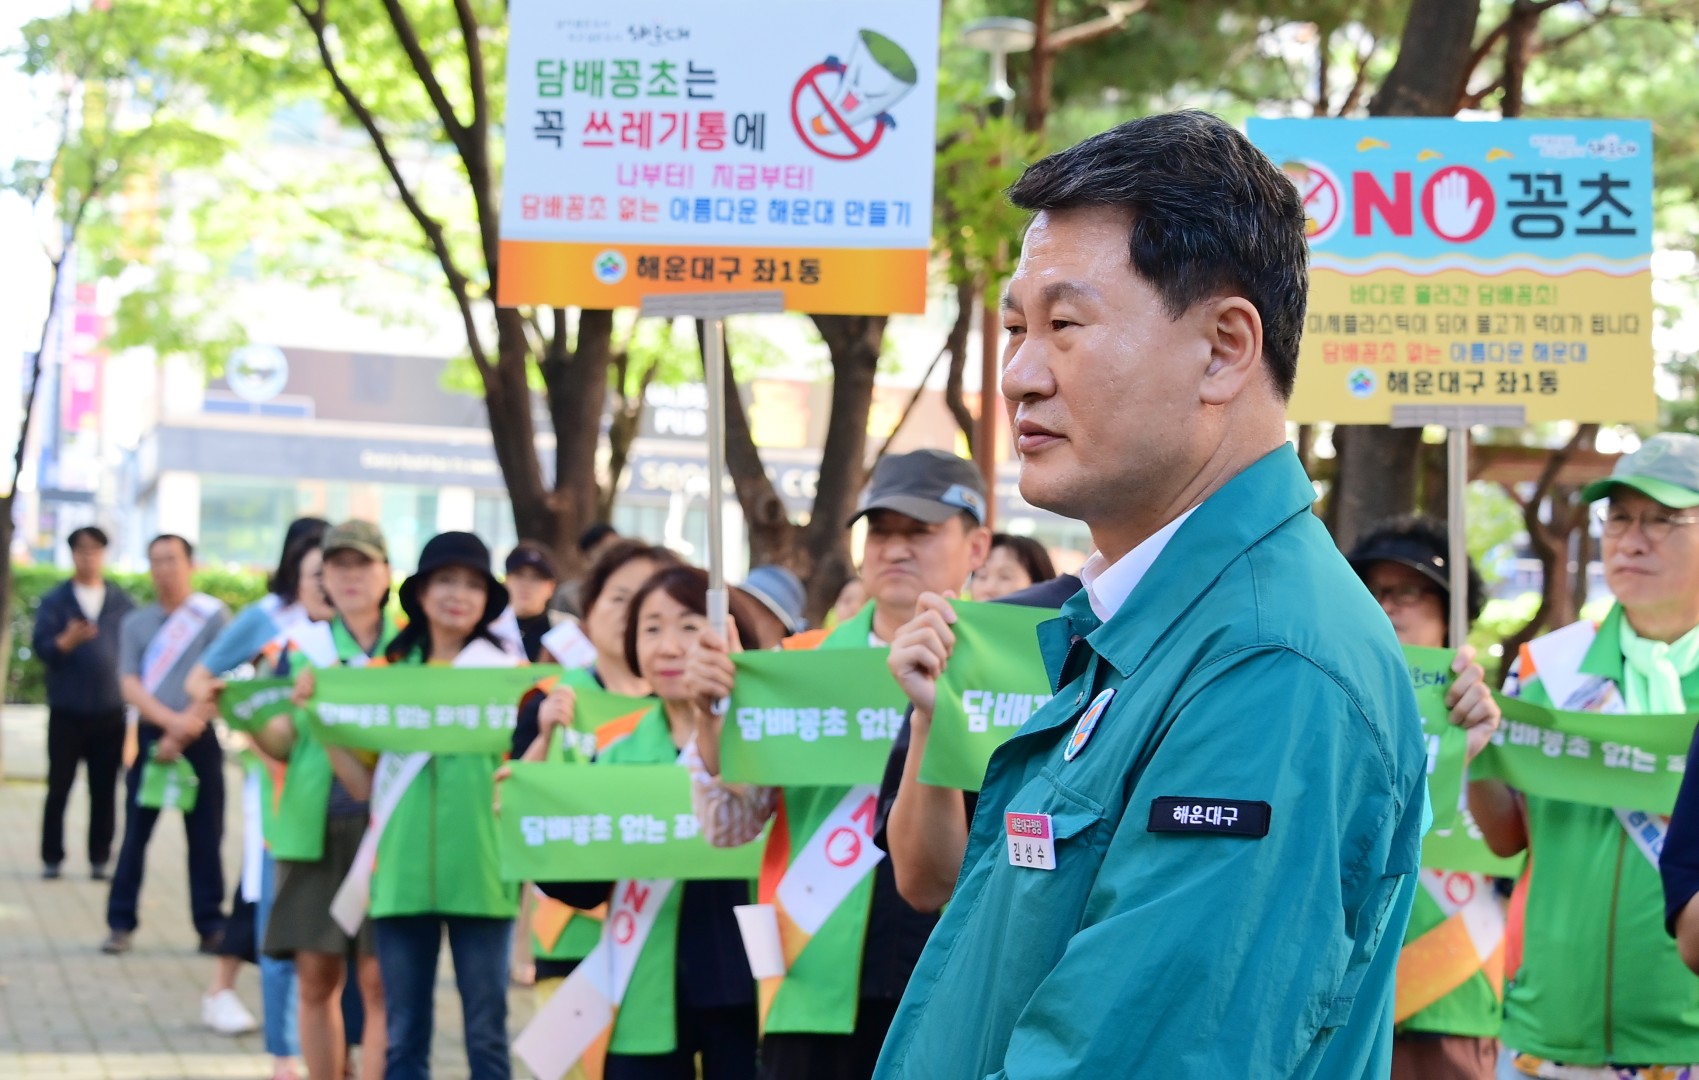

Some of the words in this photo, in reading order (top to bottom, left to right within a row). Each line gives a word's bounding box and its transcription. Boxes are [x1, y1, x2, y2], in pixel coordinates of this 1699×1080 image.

[536, 59, 717, 99] 담배꽁초는
[534, 109, 564, 148] 꼭
[582, 111, 765, 150] 쓰레기통에
[617, 163, 694, 189] 나부터!
[713, 165, 814, 190] 지금부터!
[521, 195, 606, 221] 담배꽁초
[619, 197, 659, 222] 없는
[670, 197, 758, 225] 아름다운
[768, 198, 834, 226] 해운대
[845, 200, 911, 227] 만들기
[1507, 172, 1636, 239] 꽁초
[636, 256, 741, 282] 해운대구
[753, 257, 821, 284] 좌1동
[1350, 285, 1406, 305] 바다로
[1477, 285, 1559, 306] 담배꽁초!
[1435, 315, 1468, 335] 되어
[1477, 314, 1526, 335] 물고기
[1533, 315, 1583, 335] 먹이가
[1591, 314, 1640, 335] 됩니다
[1322, 342, 1396, 364] 담배꽁초
[1407, 342, 1442, 364] 없는
[1450, 342, 1524, 364] 아름다운
[1532, 342, 1588, 364] 해운대
[1387, 370, 1485, 395] 해운대구
[1496, 370, 1559, 395] 좌1동
[736, 706, 847, 742] 담배꽁초
[1602, 740, 1657, 773] 없는
[521, 815, 612, 846] 담배꽁초
[619, 814, 667, 844] 없는
[1173, 805, 1238, 827] 해운대구
